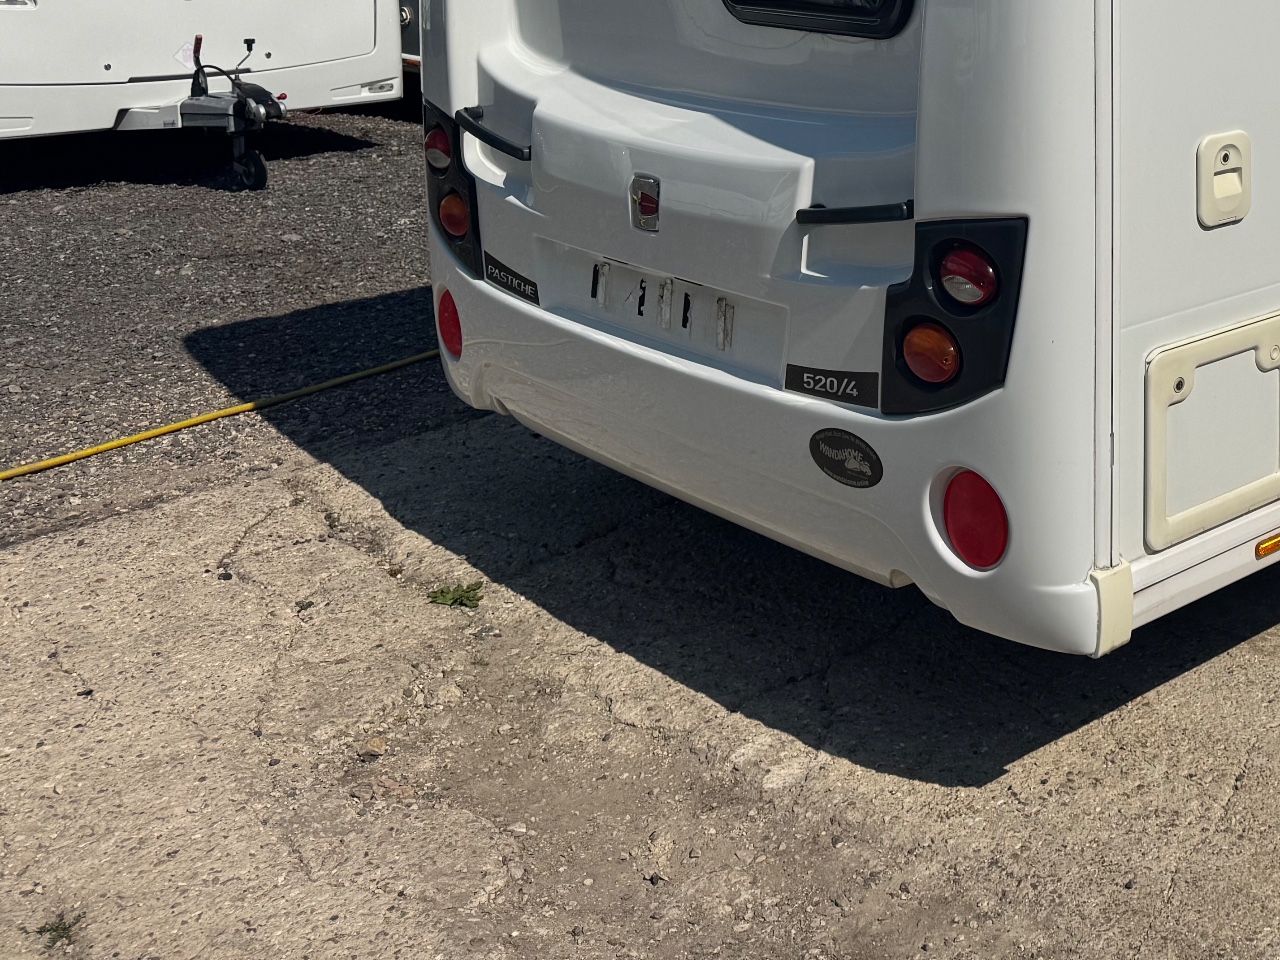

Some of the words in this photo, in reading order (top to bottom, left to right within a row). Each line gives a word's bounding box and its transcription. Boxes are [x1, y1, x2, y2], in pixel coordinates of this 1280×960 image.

[487, 264, 536, 298] PASTICHE
[802, 372, 859, 397] 520/4
[818, 440, 864, 463] WANDAHOME
